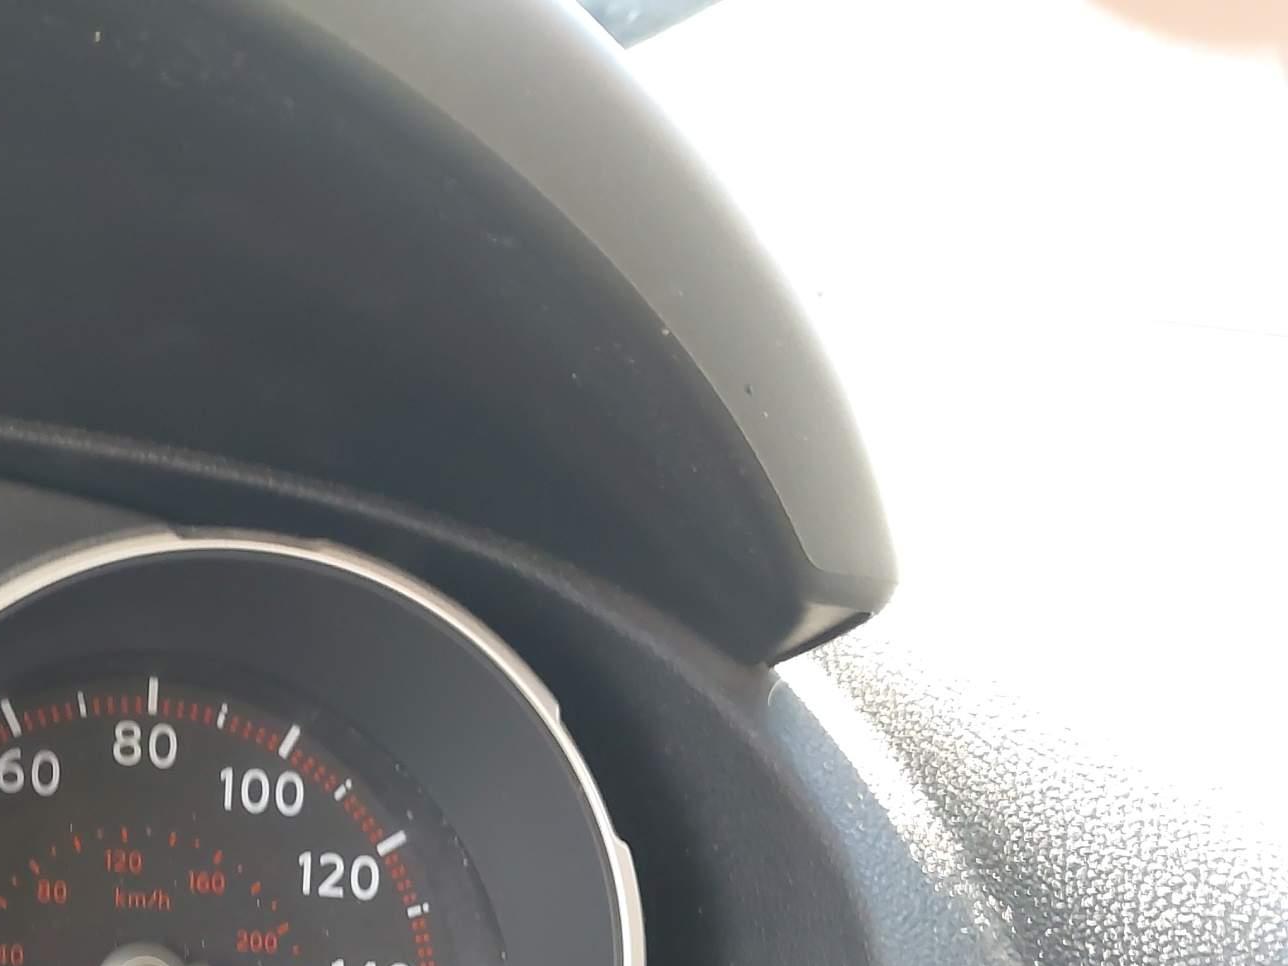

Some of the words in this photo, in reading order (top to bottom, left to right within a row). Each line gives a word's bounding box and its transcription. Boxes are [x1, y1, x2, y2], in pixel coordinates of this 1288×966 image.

[113, 721, 178, 770] 80
[220, 766, 305, 818] 100
[104, 848, 143, 875] 120
[187, 870, 226, 895] 160
[298, 851, 380, 901] 120
[37, 879, 68, 905] 80
[114, 887, 172, 912] km/h
[236, 930, 278, 954] 200
